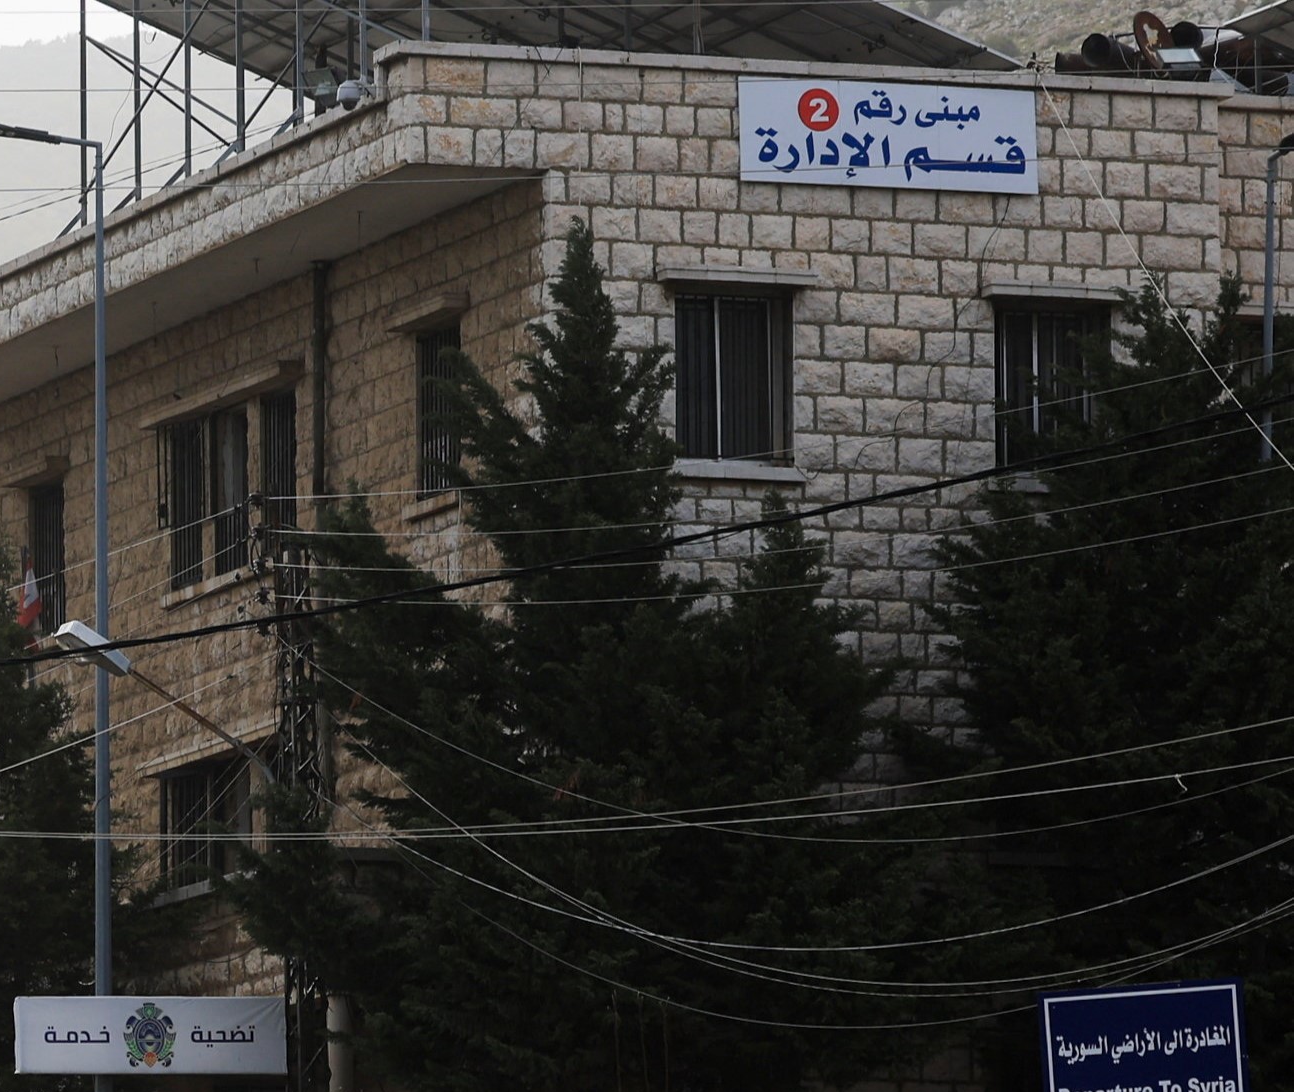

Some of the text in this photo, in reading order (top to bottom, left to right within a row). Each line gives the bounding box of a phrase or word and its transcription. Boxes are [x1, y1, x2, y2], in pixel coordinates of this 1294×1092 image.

[809, 89, 981, 131] مبنى رقم 2
[755, 127, 1027, 181] قسم الإدارة
[44, 1025, 255, 1048] تضحية خدمة
[1056, 1035, 1108, 1065] السورية
[1186, 1025, 1231, 1053] المغادرة
